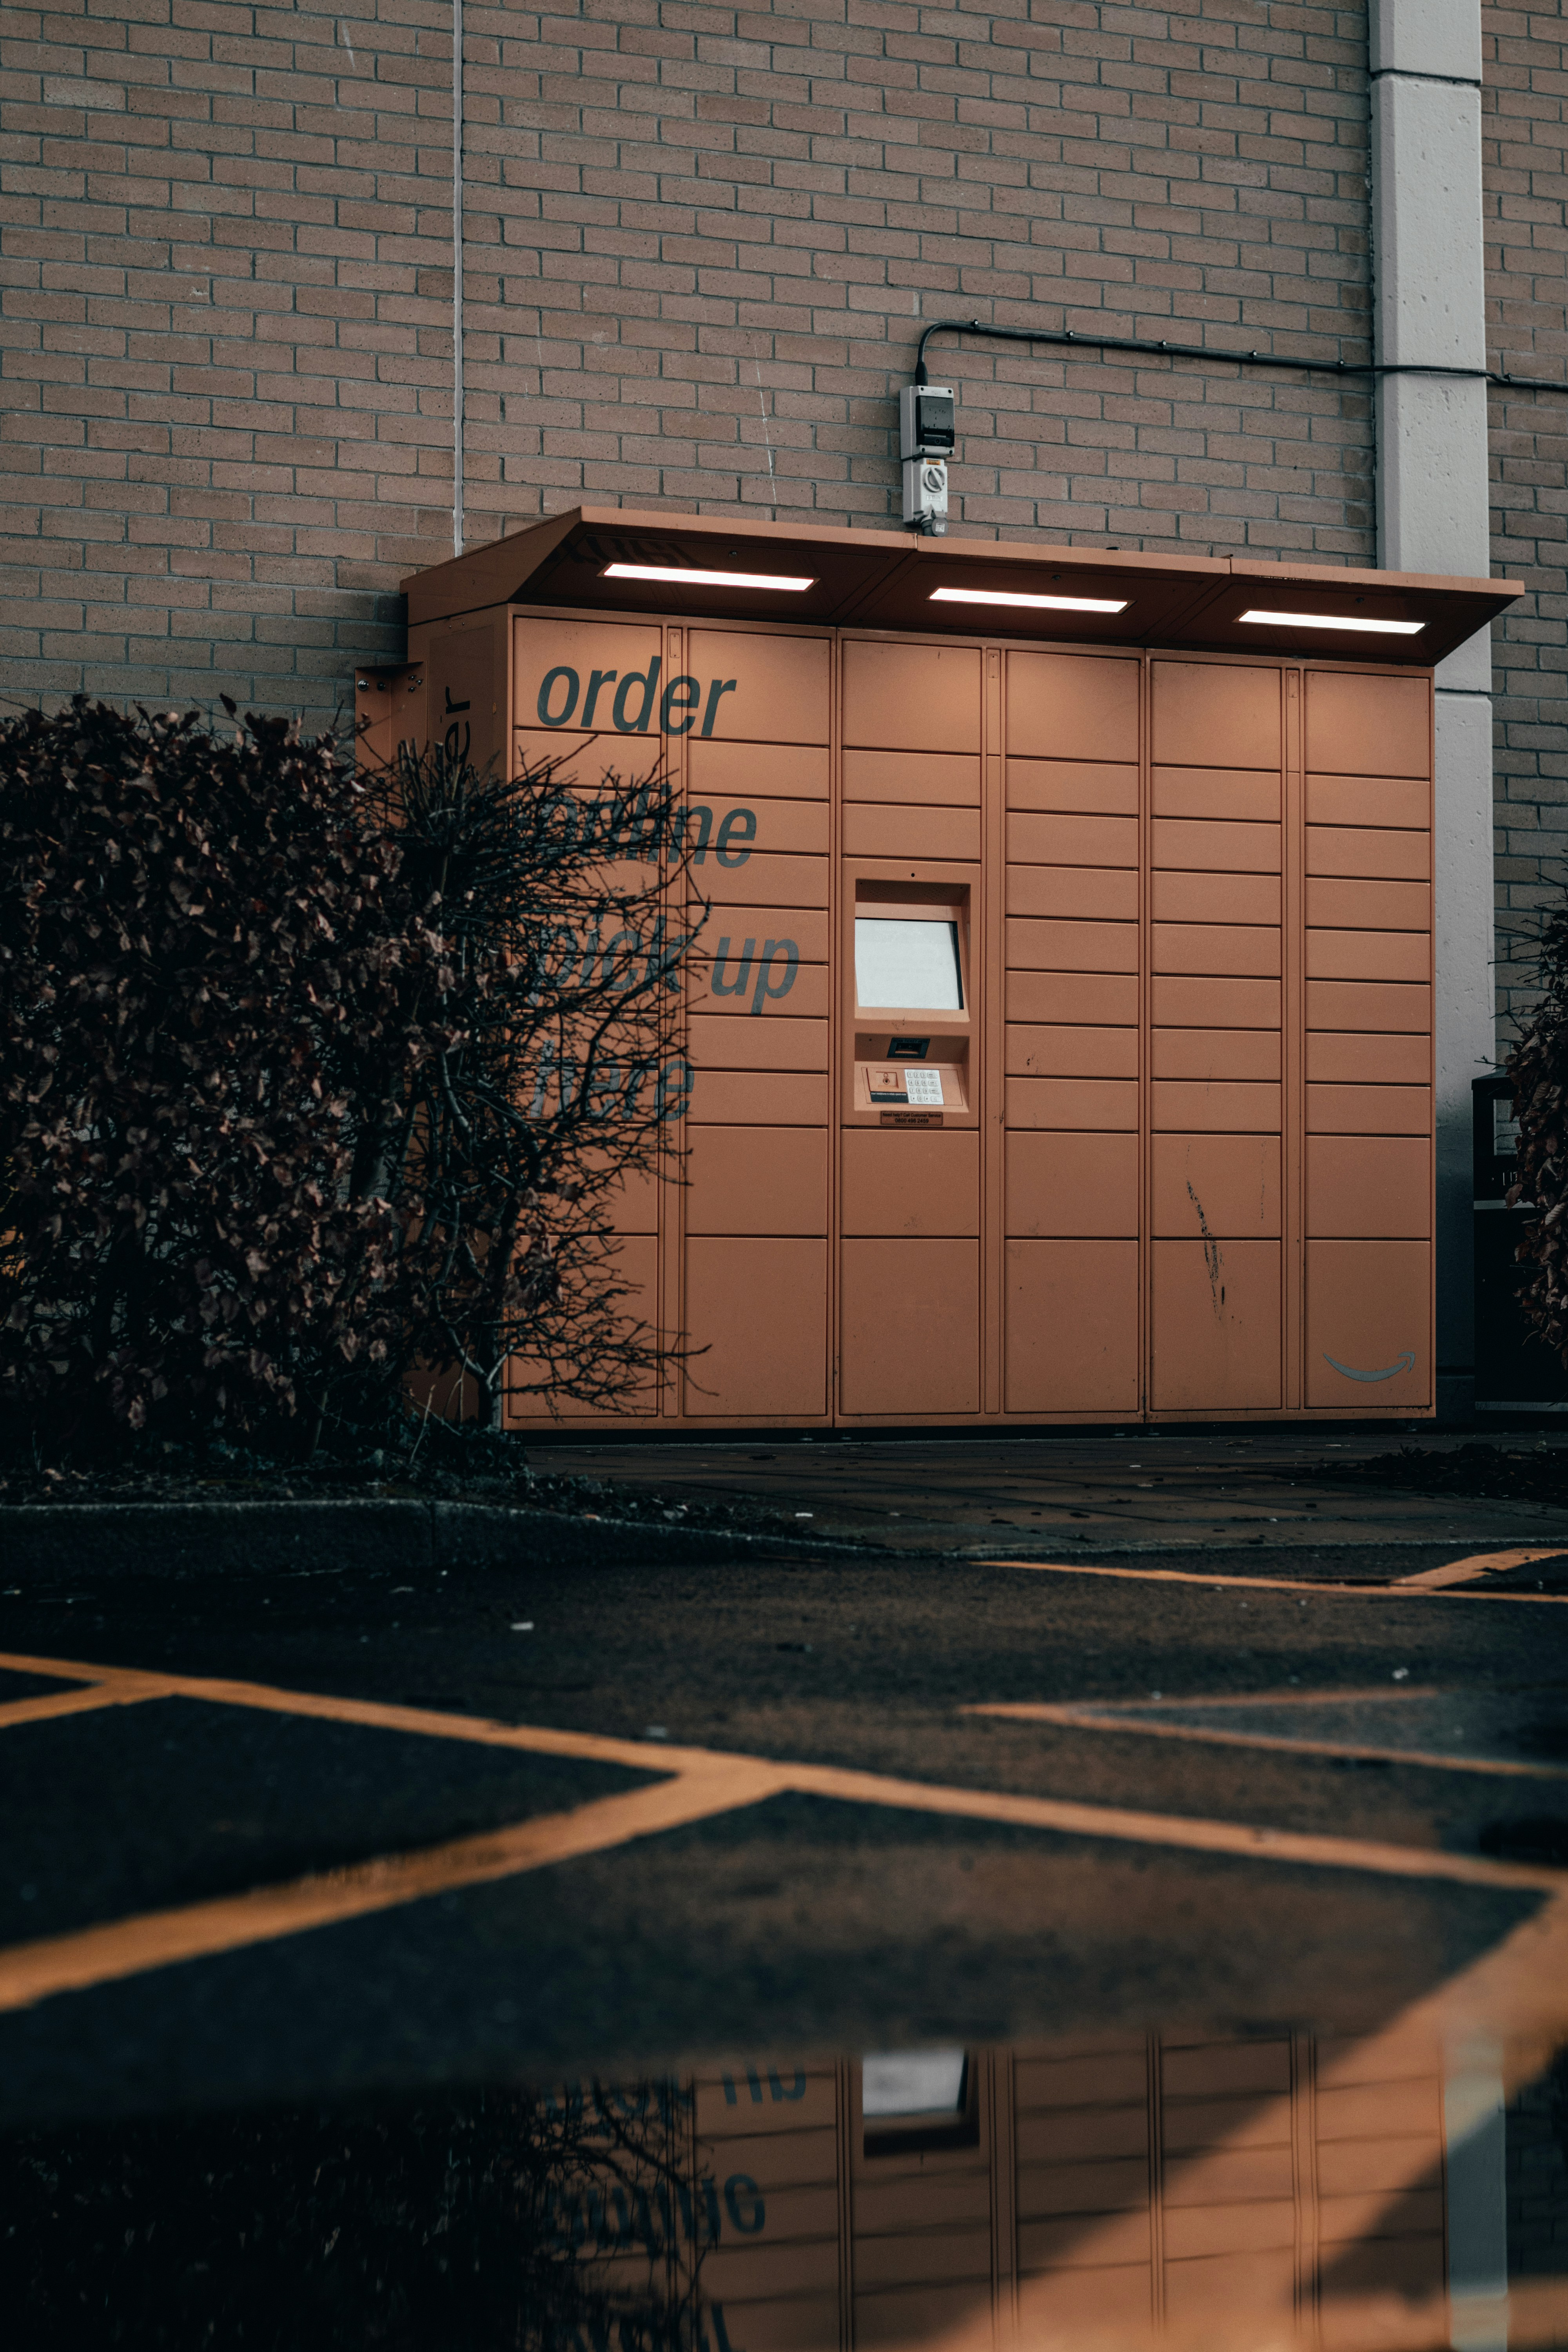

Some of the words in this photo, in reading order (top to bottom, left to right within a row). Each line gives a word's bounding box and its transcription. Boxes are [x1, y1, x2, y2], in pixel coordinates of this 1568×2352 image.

[538, 655, 737, 737] order
[540, 784, 757, 869] online
[527, 914, 690, 1005] pick
[711, 936, 799, 1016] up
[530, 1040, 695, 1122] here
